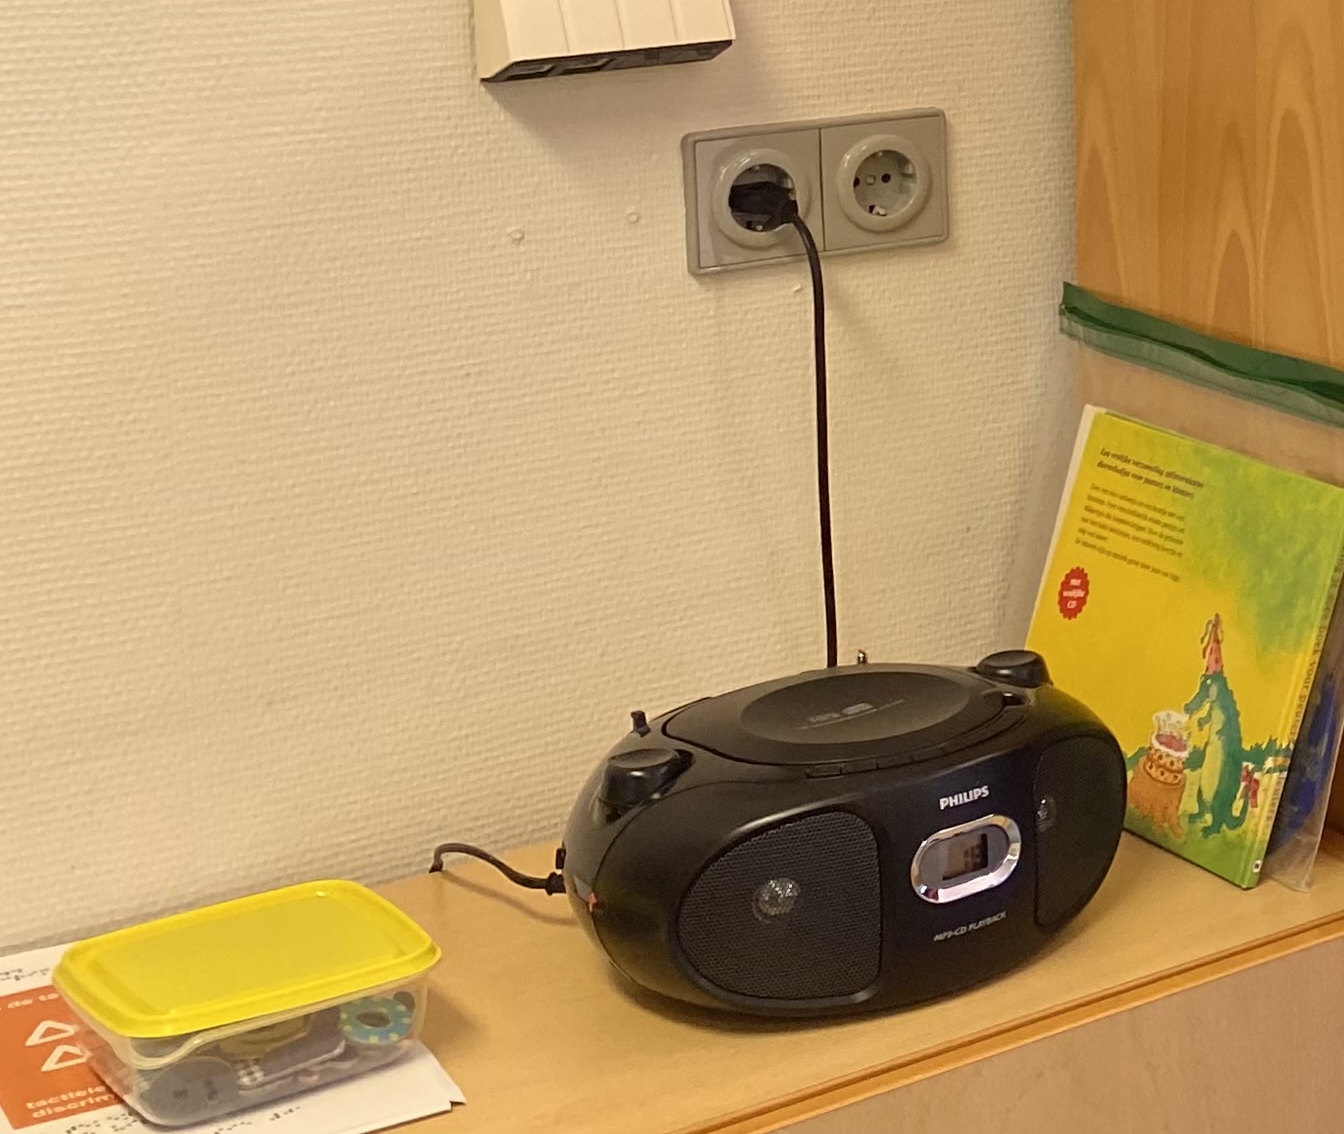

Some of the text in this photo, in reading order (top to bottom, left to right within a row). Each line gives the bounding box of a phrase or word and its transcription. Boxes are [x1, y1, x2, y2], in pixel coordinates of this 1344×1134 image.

[939, 785, 990, 811] PHILIPS
[933, 911, 1007, 943] MP3-CD PLAYBACK
